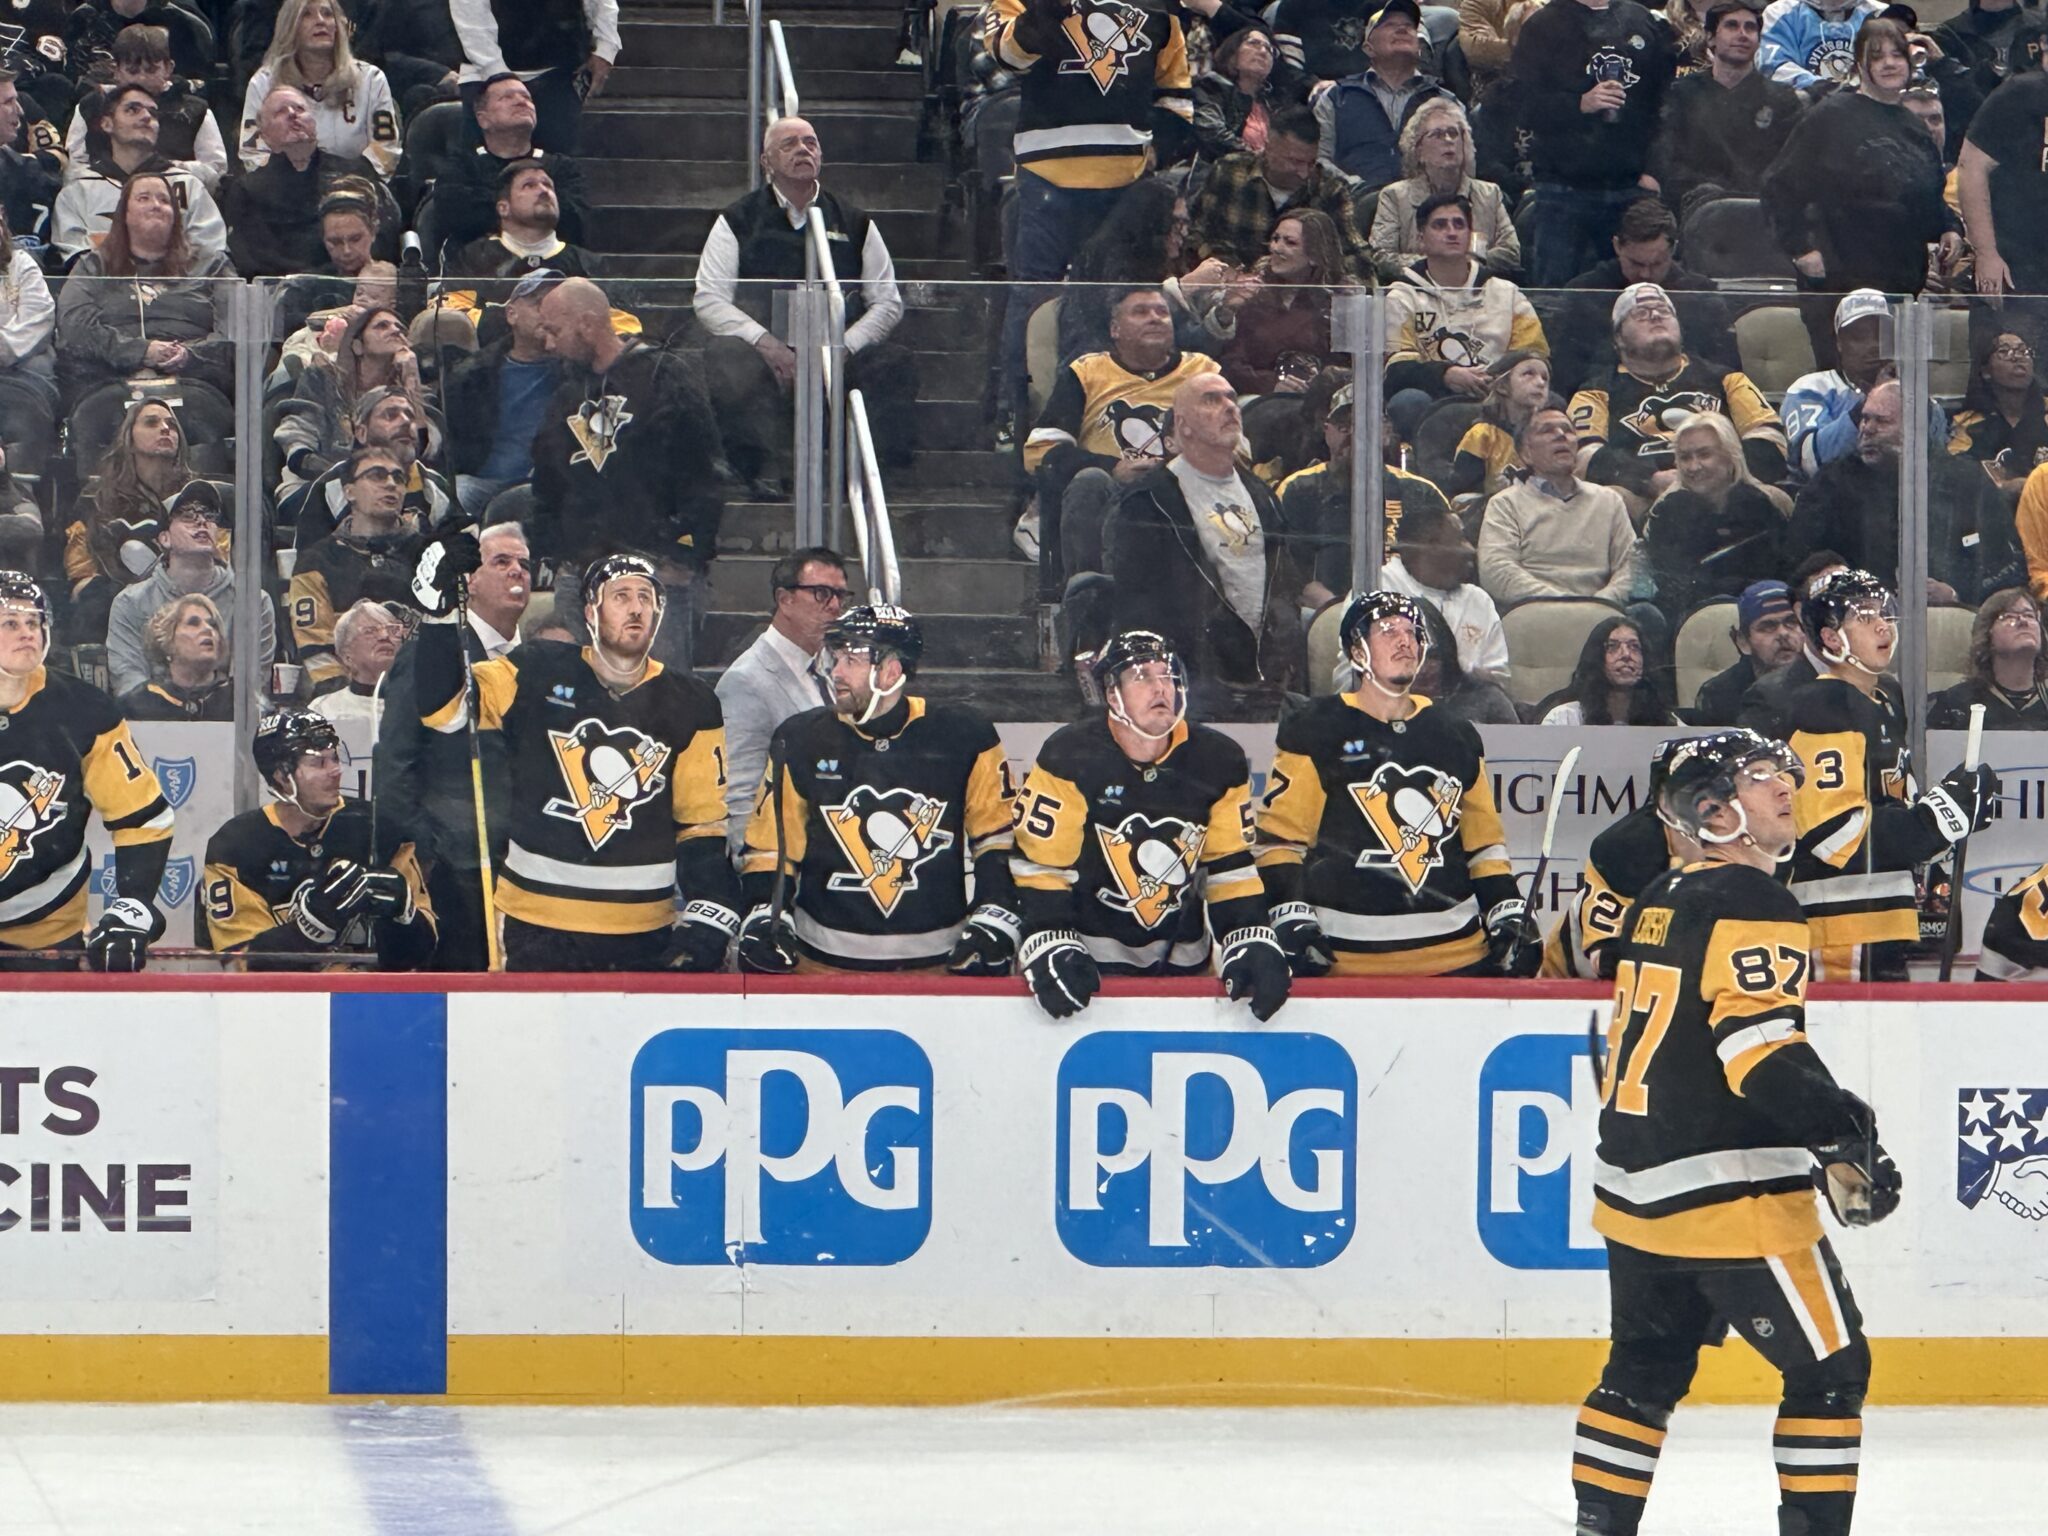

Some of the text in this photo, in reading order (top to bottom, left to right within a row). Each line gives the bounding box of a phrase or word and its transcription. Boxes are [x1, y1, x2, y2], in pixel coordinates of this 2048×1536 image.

[1766, 44, 1780, 63] 7
[373, 110, 396, 141] 8
[32, 203, 49, 234] 7
[1415, 312, 1436, 332] 87
[1573, 405, 1594, 430] 2
[1785, 403, 1824, 439] 87
[295, 596, 316, 628] 9
[113, 740, 142, 782] 1
[1813, 748, 1845, 790] 3
[1729, 944, 1808, 994] 87
[642, 1049, 920, 1244] PPG
[1069, 1052, 1345, 1247] PPG
